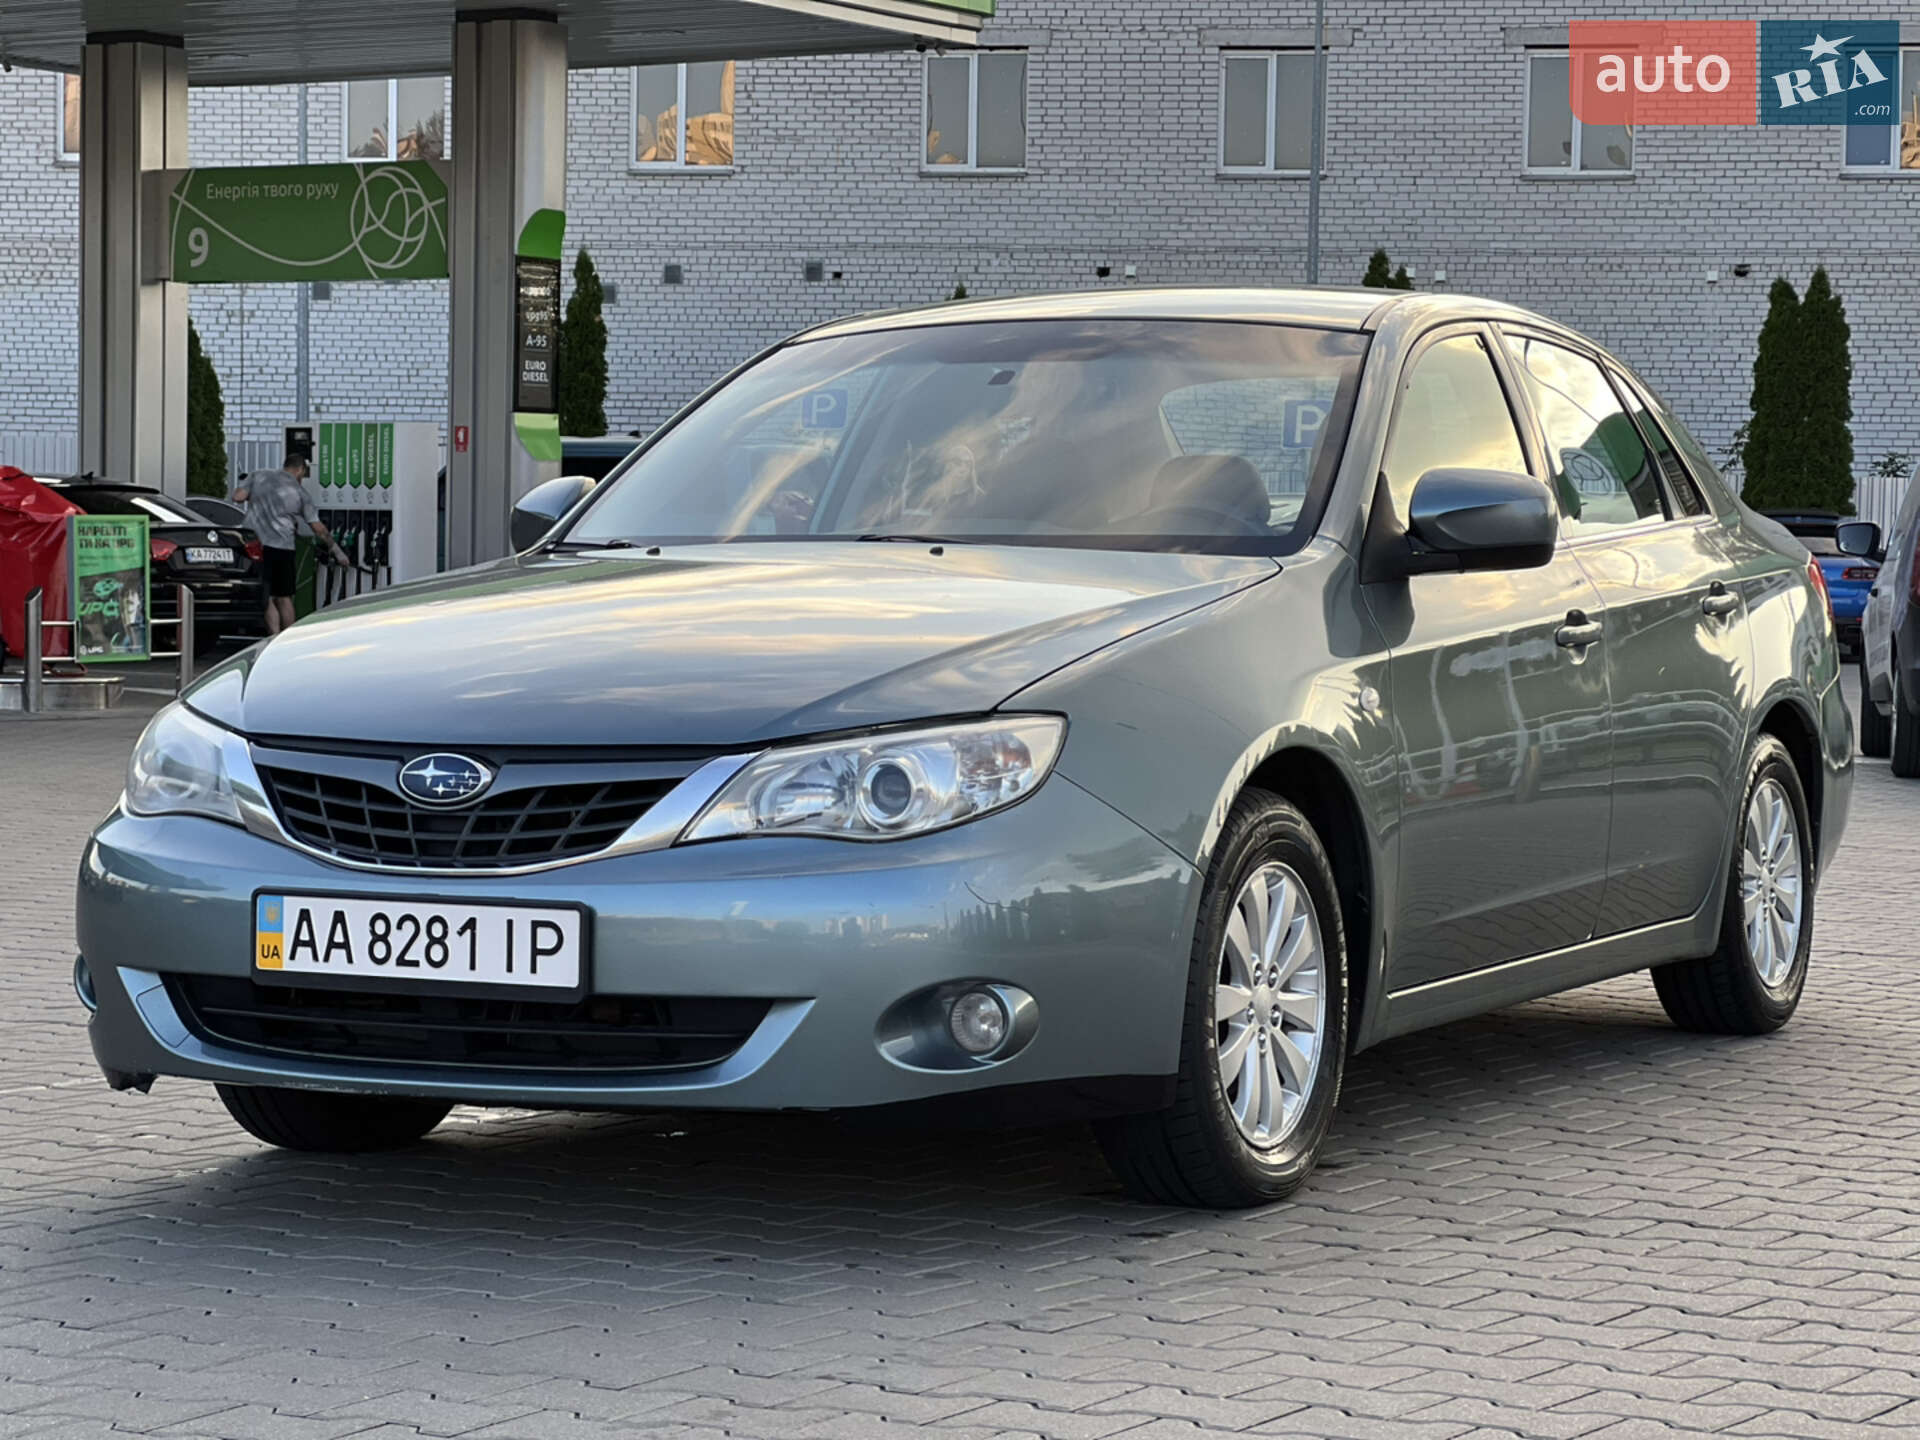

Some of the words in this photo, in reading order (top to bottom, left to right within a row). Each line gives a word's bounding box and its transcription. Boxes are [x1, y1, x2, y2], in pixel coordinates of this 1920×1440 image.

[206, 181, 259, 201] Енергія
[263, 183, 303, 198] твого
[306, 181, 339, 200] руху
[188, 227, 209, 268] 9
[525, 335, 547, 347] A-95
[525, 360, 546, 371] EURO
[522, 371, 549, 383] DIESEL
[812, 394, 836, 425] P
[1295, 405, 1327, 443] P
[289, 908, 354, 965] AA
[367, 911, 478, 971] 8281
[505, 918, 564, 974] IP
[261, 944, 281, 959] UA
